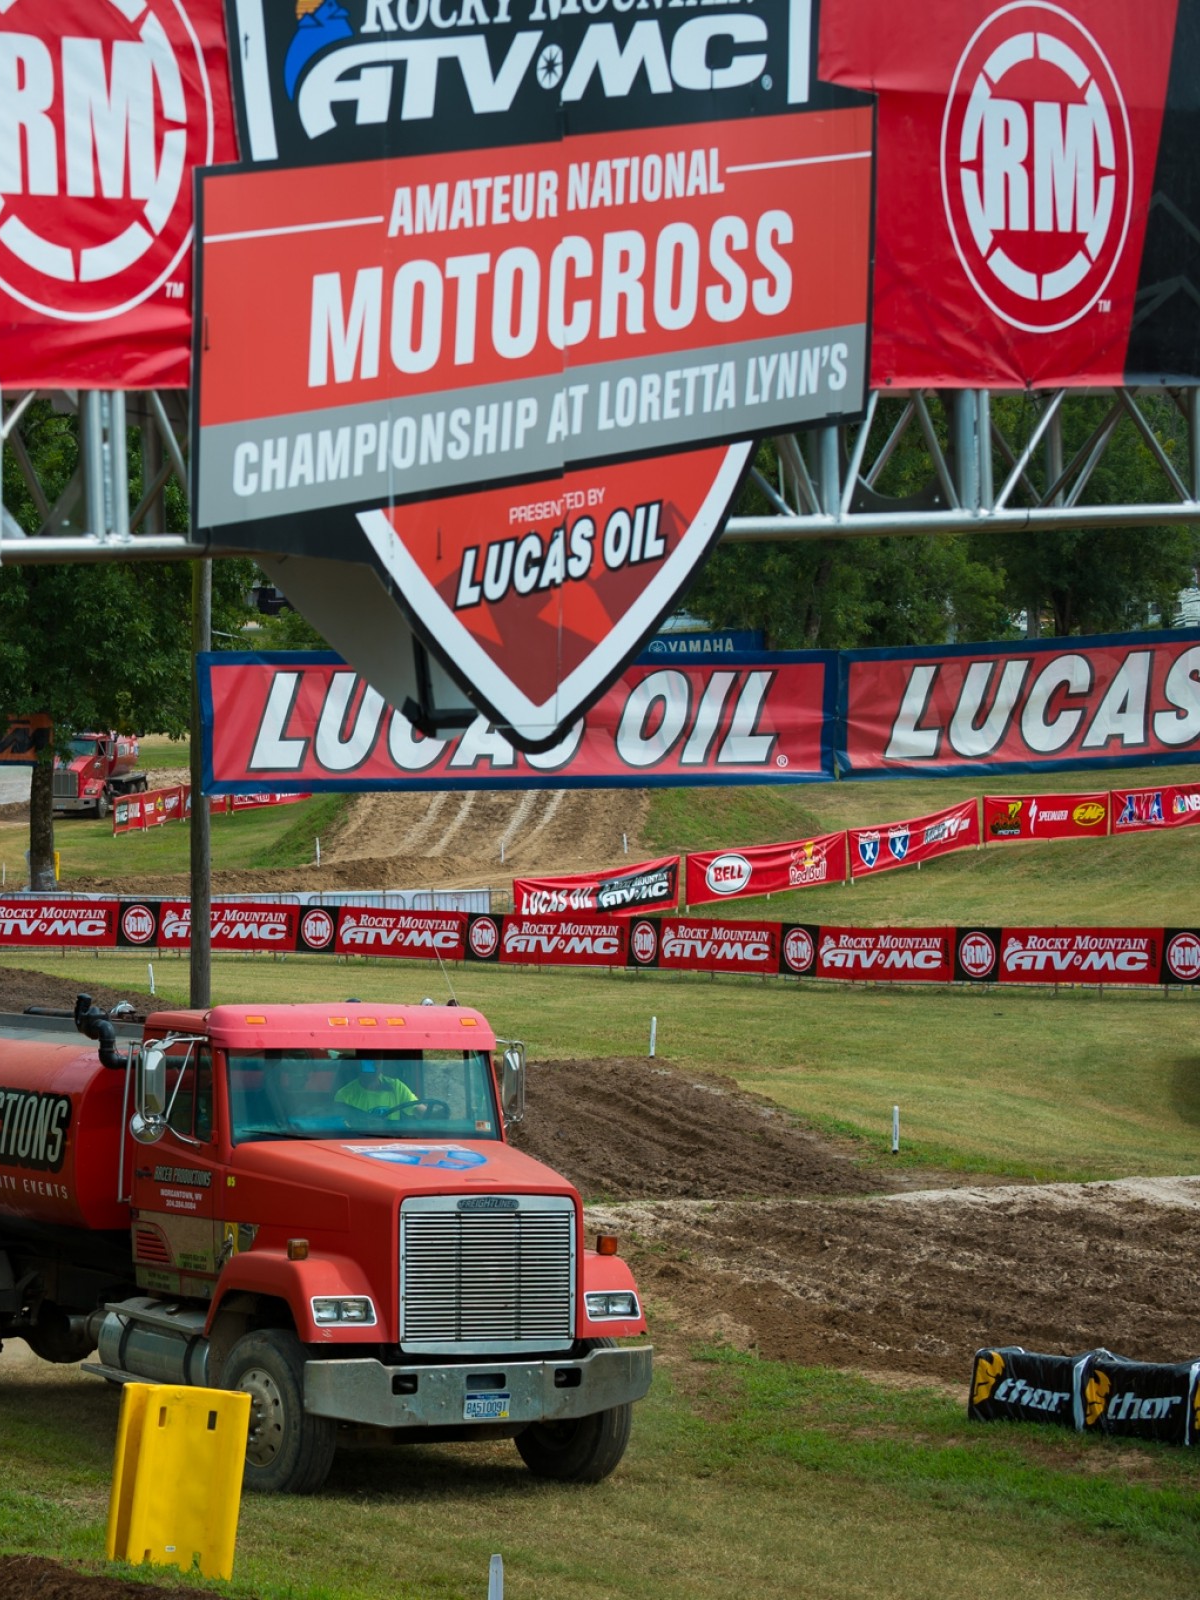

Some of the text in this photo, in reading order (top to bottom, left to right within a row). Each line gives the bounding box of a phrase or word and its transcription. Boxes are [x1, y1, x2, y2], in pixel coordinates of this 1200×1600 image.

[983, 97, 1096, 234] RM
[388, 148, 725, 238] AMATEUR NATIONAL
[308, 209, 794, 388] MOTOCROSS
[232, 342, 849, 497] CHAMPIONSHIP AT LORETTA LYNN'S
[509, 487, 606, 525] PRESENTED BY
[453, 499, 668, 610] LUCAS OIL
[668, 638, 734, 652] YAMAHA
[884, 645, 1200, 760] LUCAS
[615, 668, 780, 767] OIL
[1073, 806, 1105, 820] FMF
[1116, 793, 1164, 824] AMA
[713, 865, 743, 883] BELL
[789, 860, 827, 885] Red Bull
[38, 907, 106, 919] MOUNTAIN
[521, 886, 593, 915] LUCAS OIL
[223, 909, 287, 923] MOUNTAIN
[359, 914, 460, 931] ROCKY MOUNTAIN
[521, 921, 619, 936] ROCKY MOUNTAIN
[677, 925, 769, 942] ROCKY MOUNTAIN
[838, 935, 942, 949] ROCKY MOUNTAIN
[1025, 935, 1148, 950] ROCKY MOUNTAIN
[23, 1179, 68, 1199] EVENTS
[173, 1168, 211, 1187] PRODUCTIONS
[994, 1378, 1070, 1413] thor
[1107, 1392, 1182, 1420] thor
